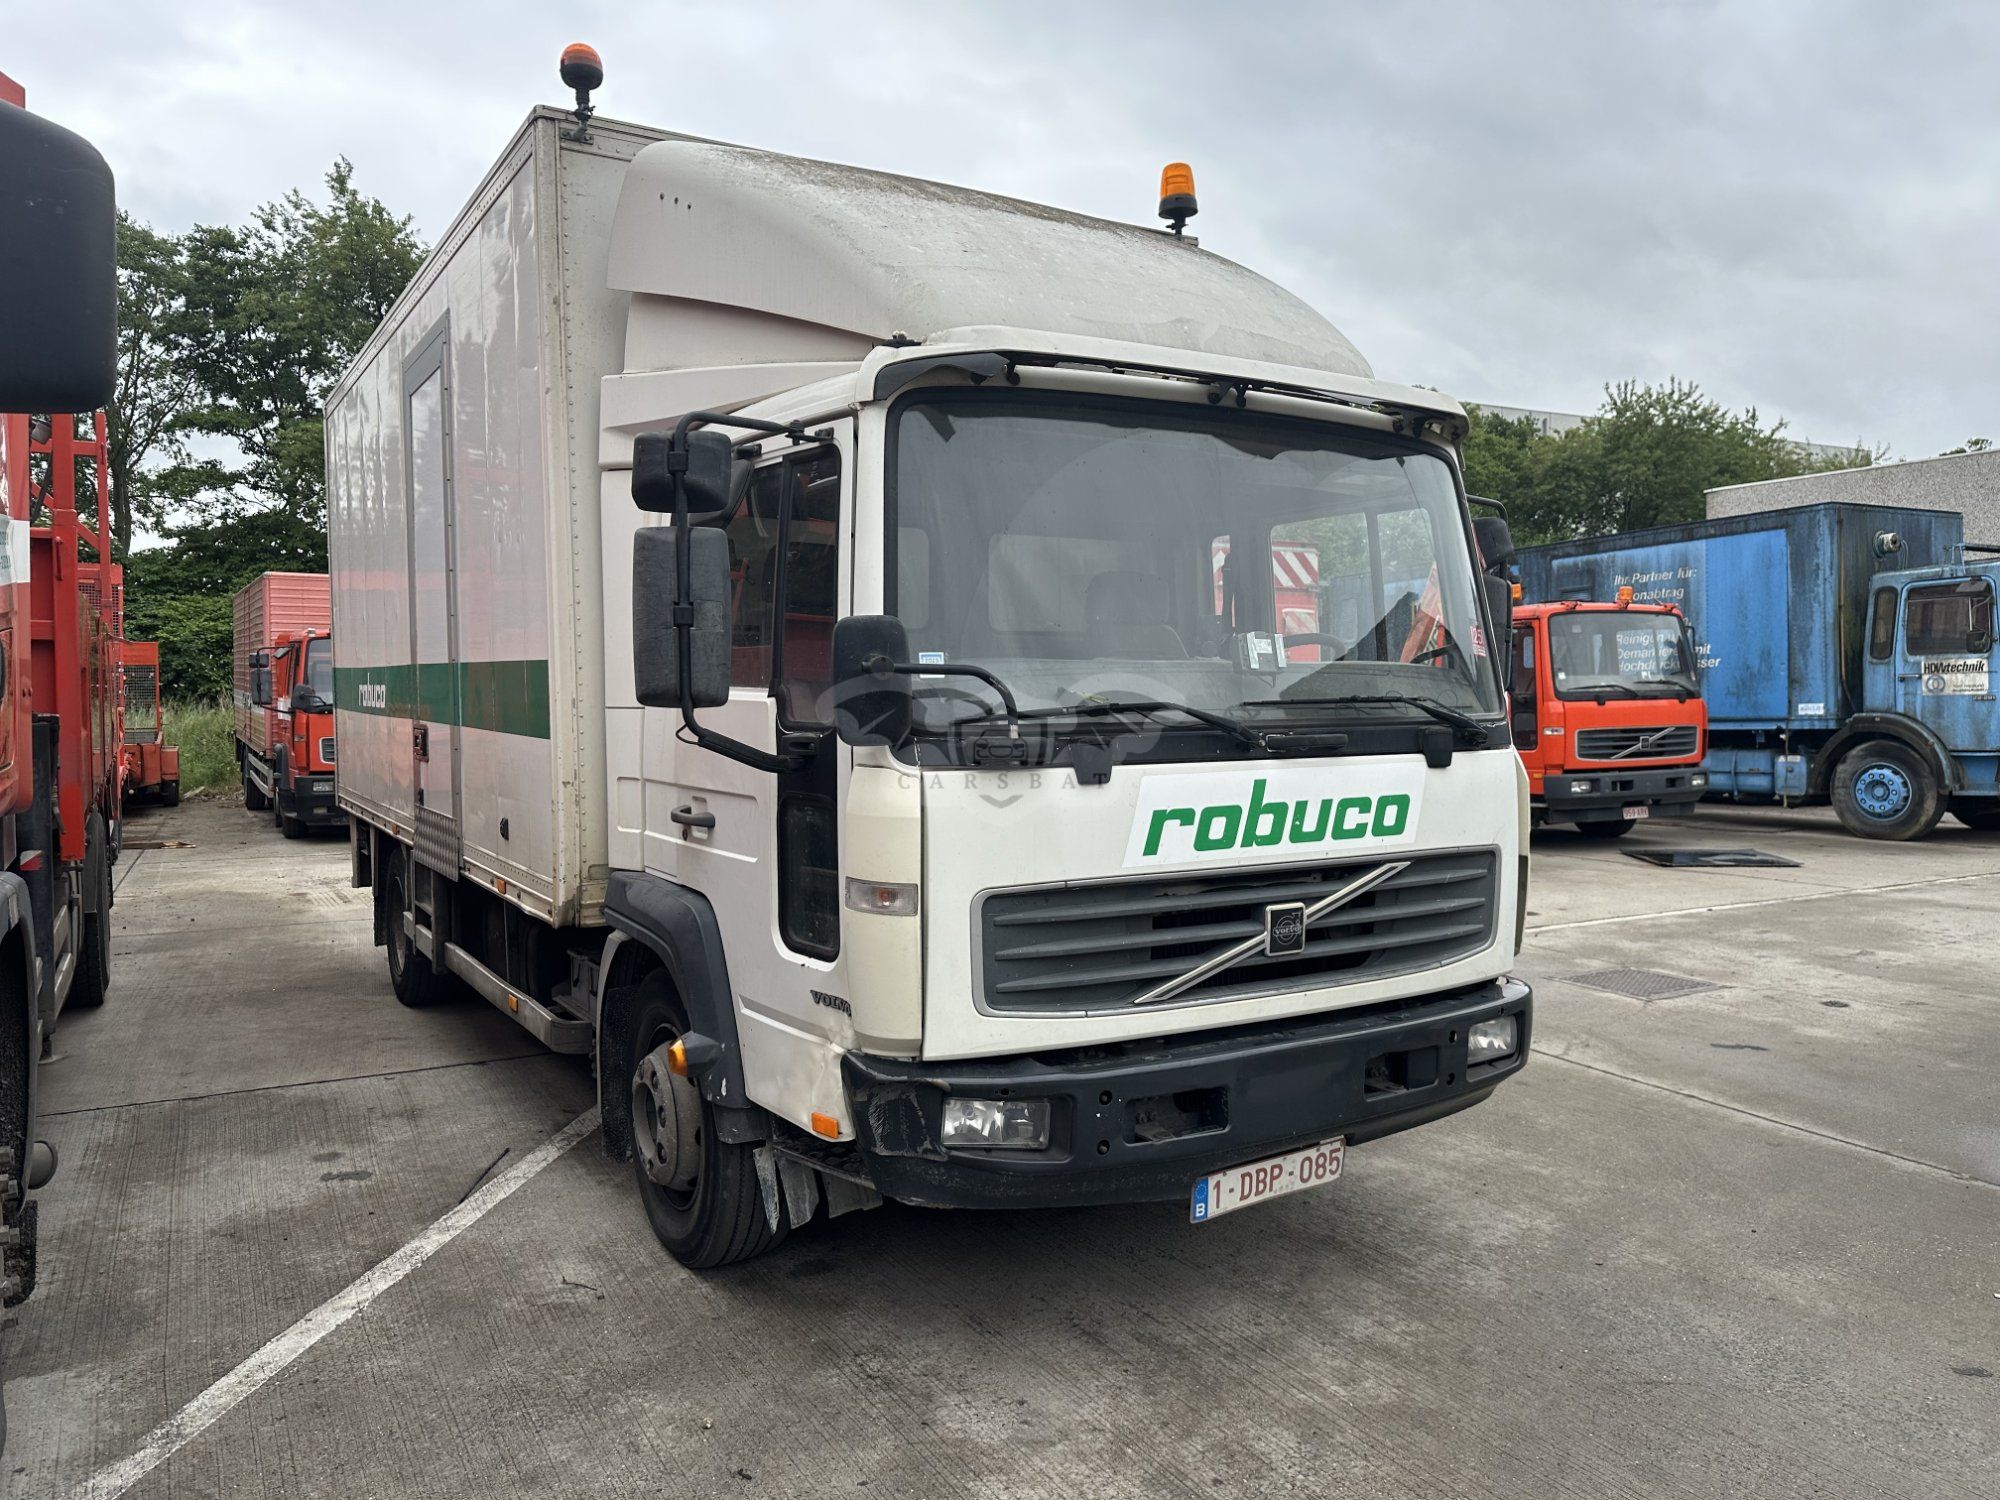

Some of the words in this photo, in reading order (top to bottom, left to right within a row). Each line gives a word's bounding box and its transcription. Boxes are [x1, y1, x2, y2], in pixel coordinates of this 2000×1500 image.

[1614, 575, 1629, 586] Ihr
[1632, 571, 1673, 584] Partner
[1924, 661, 1985, 674] HDWtechnik
[359, 672, 386, 708] robuco
[1142, 778, 1411, 857] robuco
[1274, 925, 1301, 935] VOLVO
[810, 989, 852, 1018] VOLVO
[1195, 1203, 1206, 1217] B
